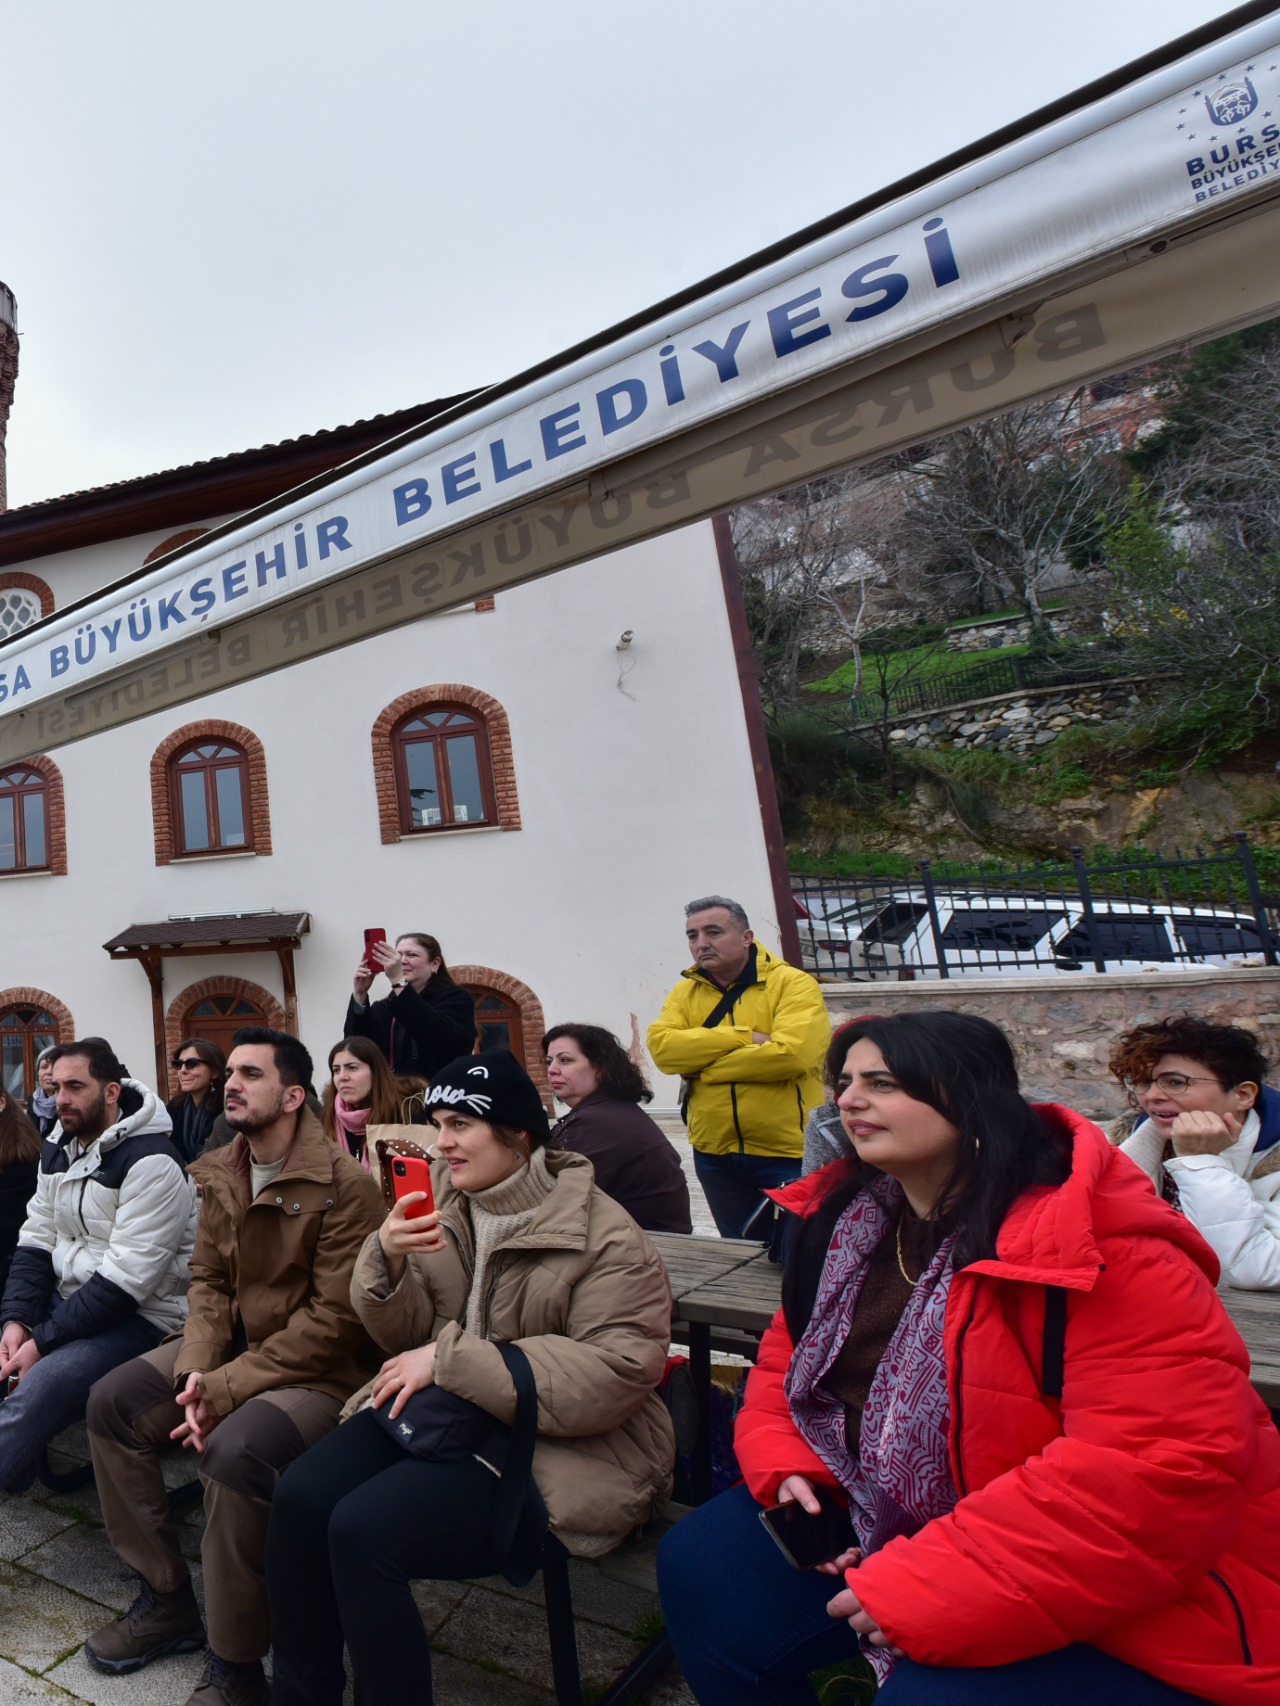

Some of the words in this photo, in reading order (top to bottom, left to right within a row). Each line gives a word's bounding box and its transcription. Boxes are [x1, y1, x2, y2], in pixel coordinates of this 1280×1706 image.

[1191, 142, 1280, 190] BÜYÜKŞE
[49, 515, 353, 679] BÜYÜKŞEHİR
[393, 217, 961, 526] BELEDİYESİ
